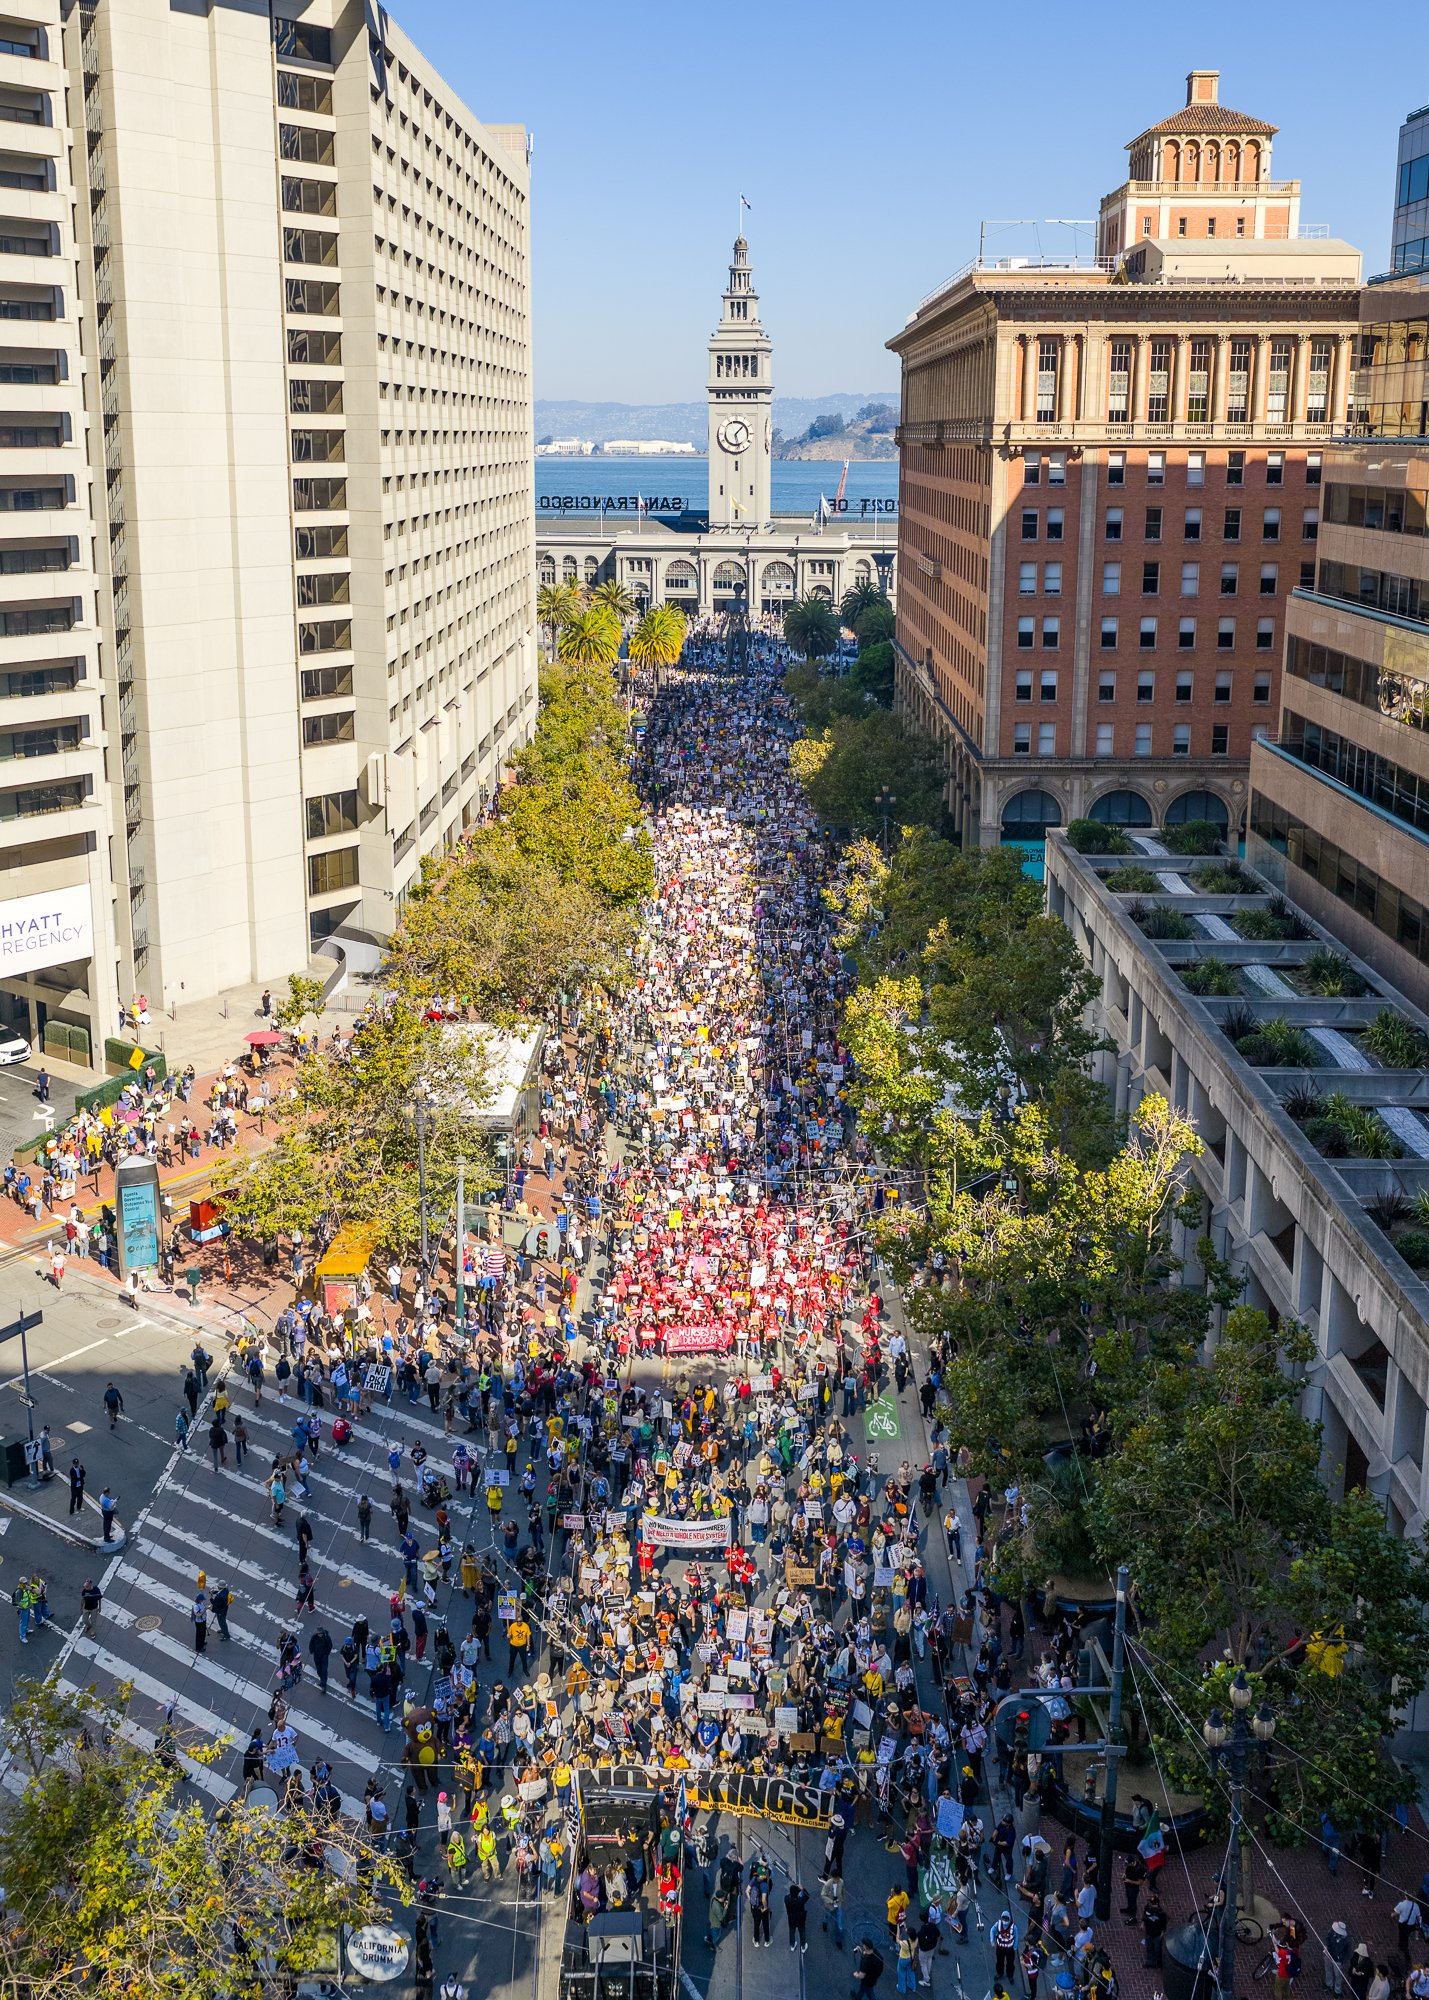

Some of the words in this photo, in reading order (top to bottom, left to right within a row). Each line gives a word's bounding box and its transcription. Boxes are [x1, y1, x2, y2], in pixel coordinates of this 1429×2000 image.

[2, 912, 62, 939] HYATT
[3, 924, 83, 956] REGENCY
[679, 1328, 710, 1337] NURSES
[710, 1329, 724, 1338] FOR
[683, 1336, 727, 1346] DEMOCRACY
[692, 1532, 705, 1540] NEW
[697, 1770, 832, 1822] KINGS!
[720, 1803, 745, 1813] DEMAND
[784, 1815, 797, 1823] NOT
[353, 1940, 403, 1955] CALIFORNIA
[362, 1952, 393, 1965] DRUMM
